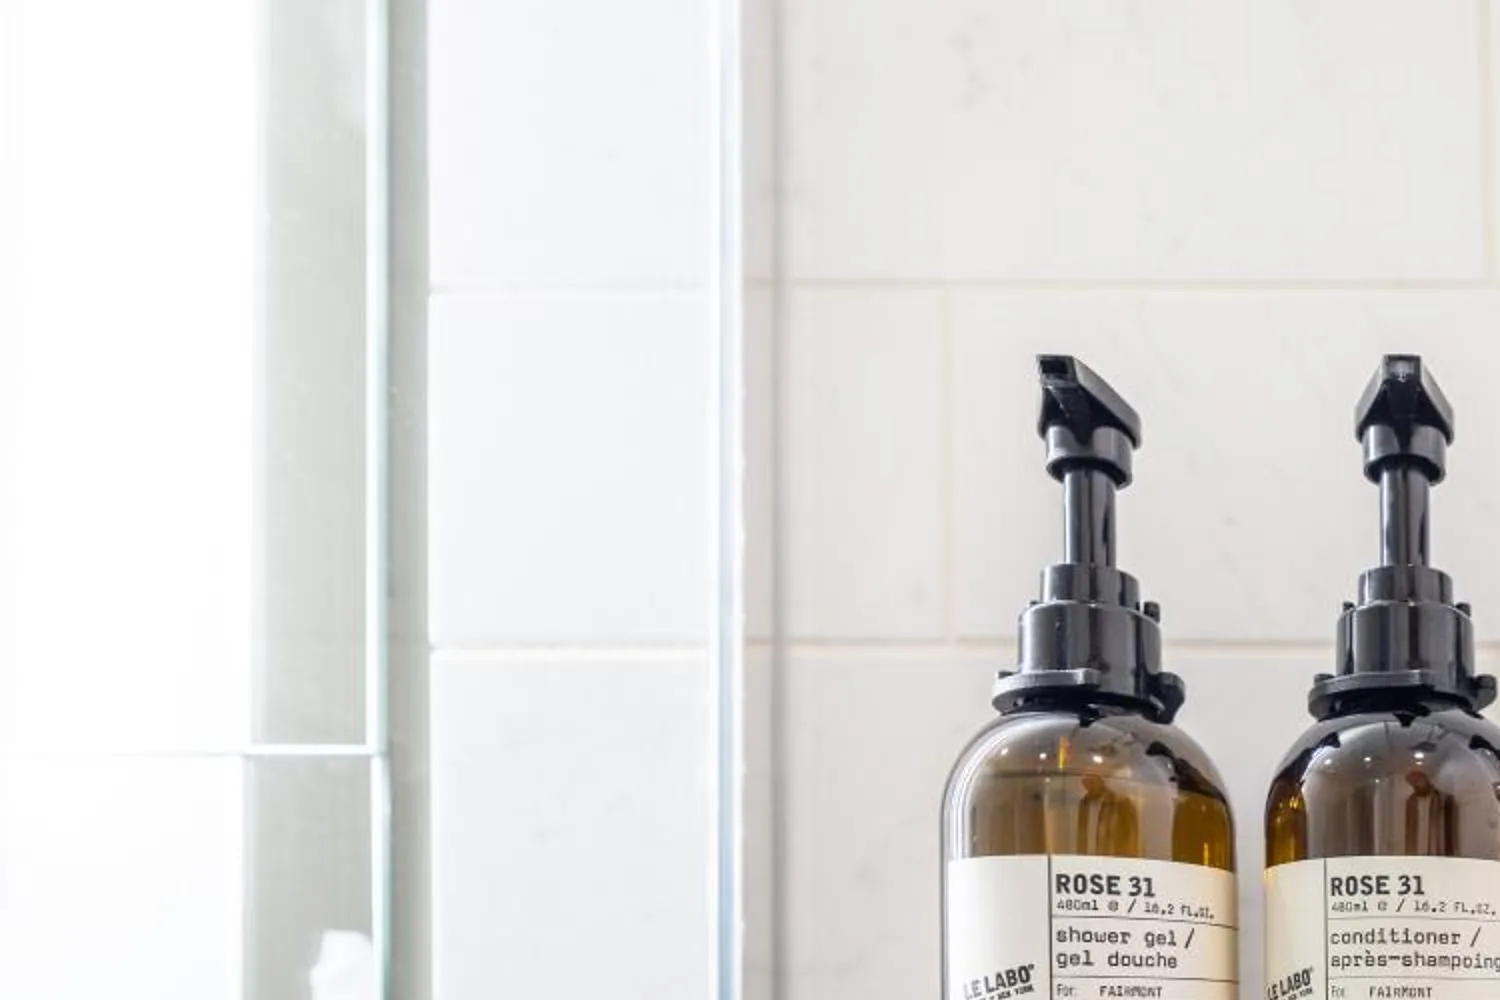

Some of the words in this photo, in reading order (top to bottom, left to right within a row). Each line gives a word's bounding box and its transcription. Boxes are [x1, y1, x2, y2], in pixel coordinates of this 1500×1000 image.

[1056, 874, 1120, 895] ROSE
[1129, 877, 1155, 897] 31
[1331, 876, 1390, 896] ROSE
[1398, 876, 1424, 895] 31
[1057, 899, 1098, 910] 480ml
[1332, 901, 1368, 912] 480ml
[1415, 902, 1448, 912] 16.2
[1056, 926, 1131, 944] shower
[1144, 930, 1176, 947] gel
[1331, 928, 1460, 944] conditioner
[1056, 951, 1094, 968] gel
[1108, 951, 1177, 968] douche
[1099, 986, 1162, 998] FAIRMONT
[1369, 987, 1432, 998] FAIRMONT
